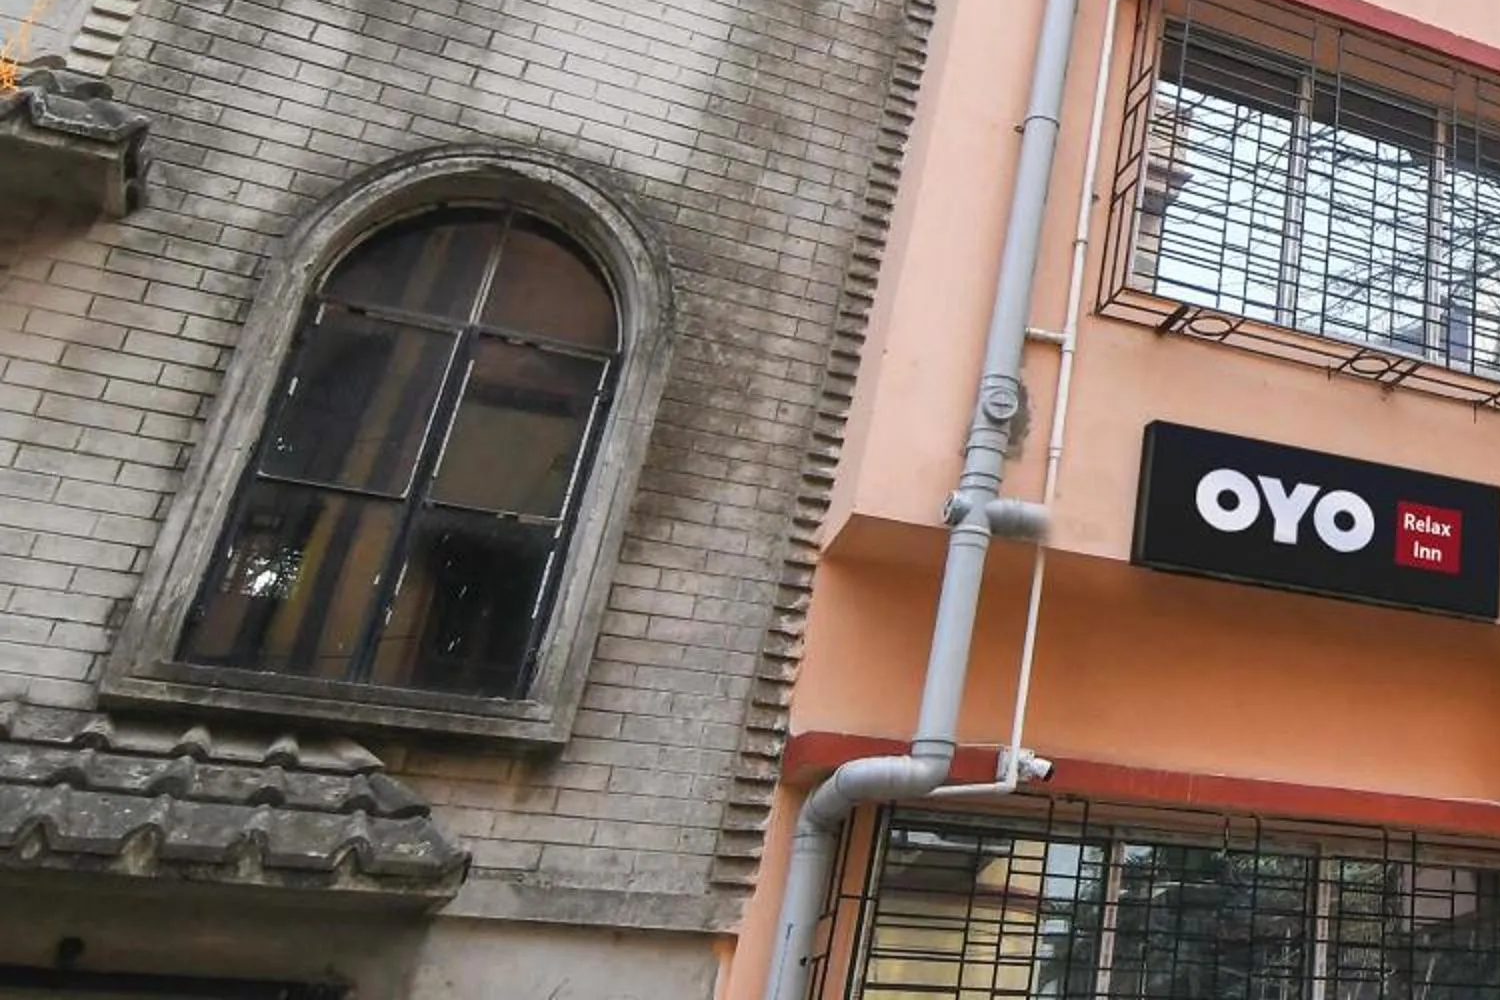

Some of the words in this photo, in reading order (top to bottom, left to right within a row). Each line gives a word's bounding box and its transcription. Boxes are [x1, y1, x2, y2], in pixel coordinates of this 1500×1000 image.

[1195, 468, 1375, 553] OYO
[1403, 513, 1451, 537] Relax
[1413, 541, 1442, 562] Inn
